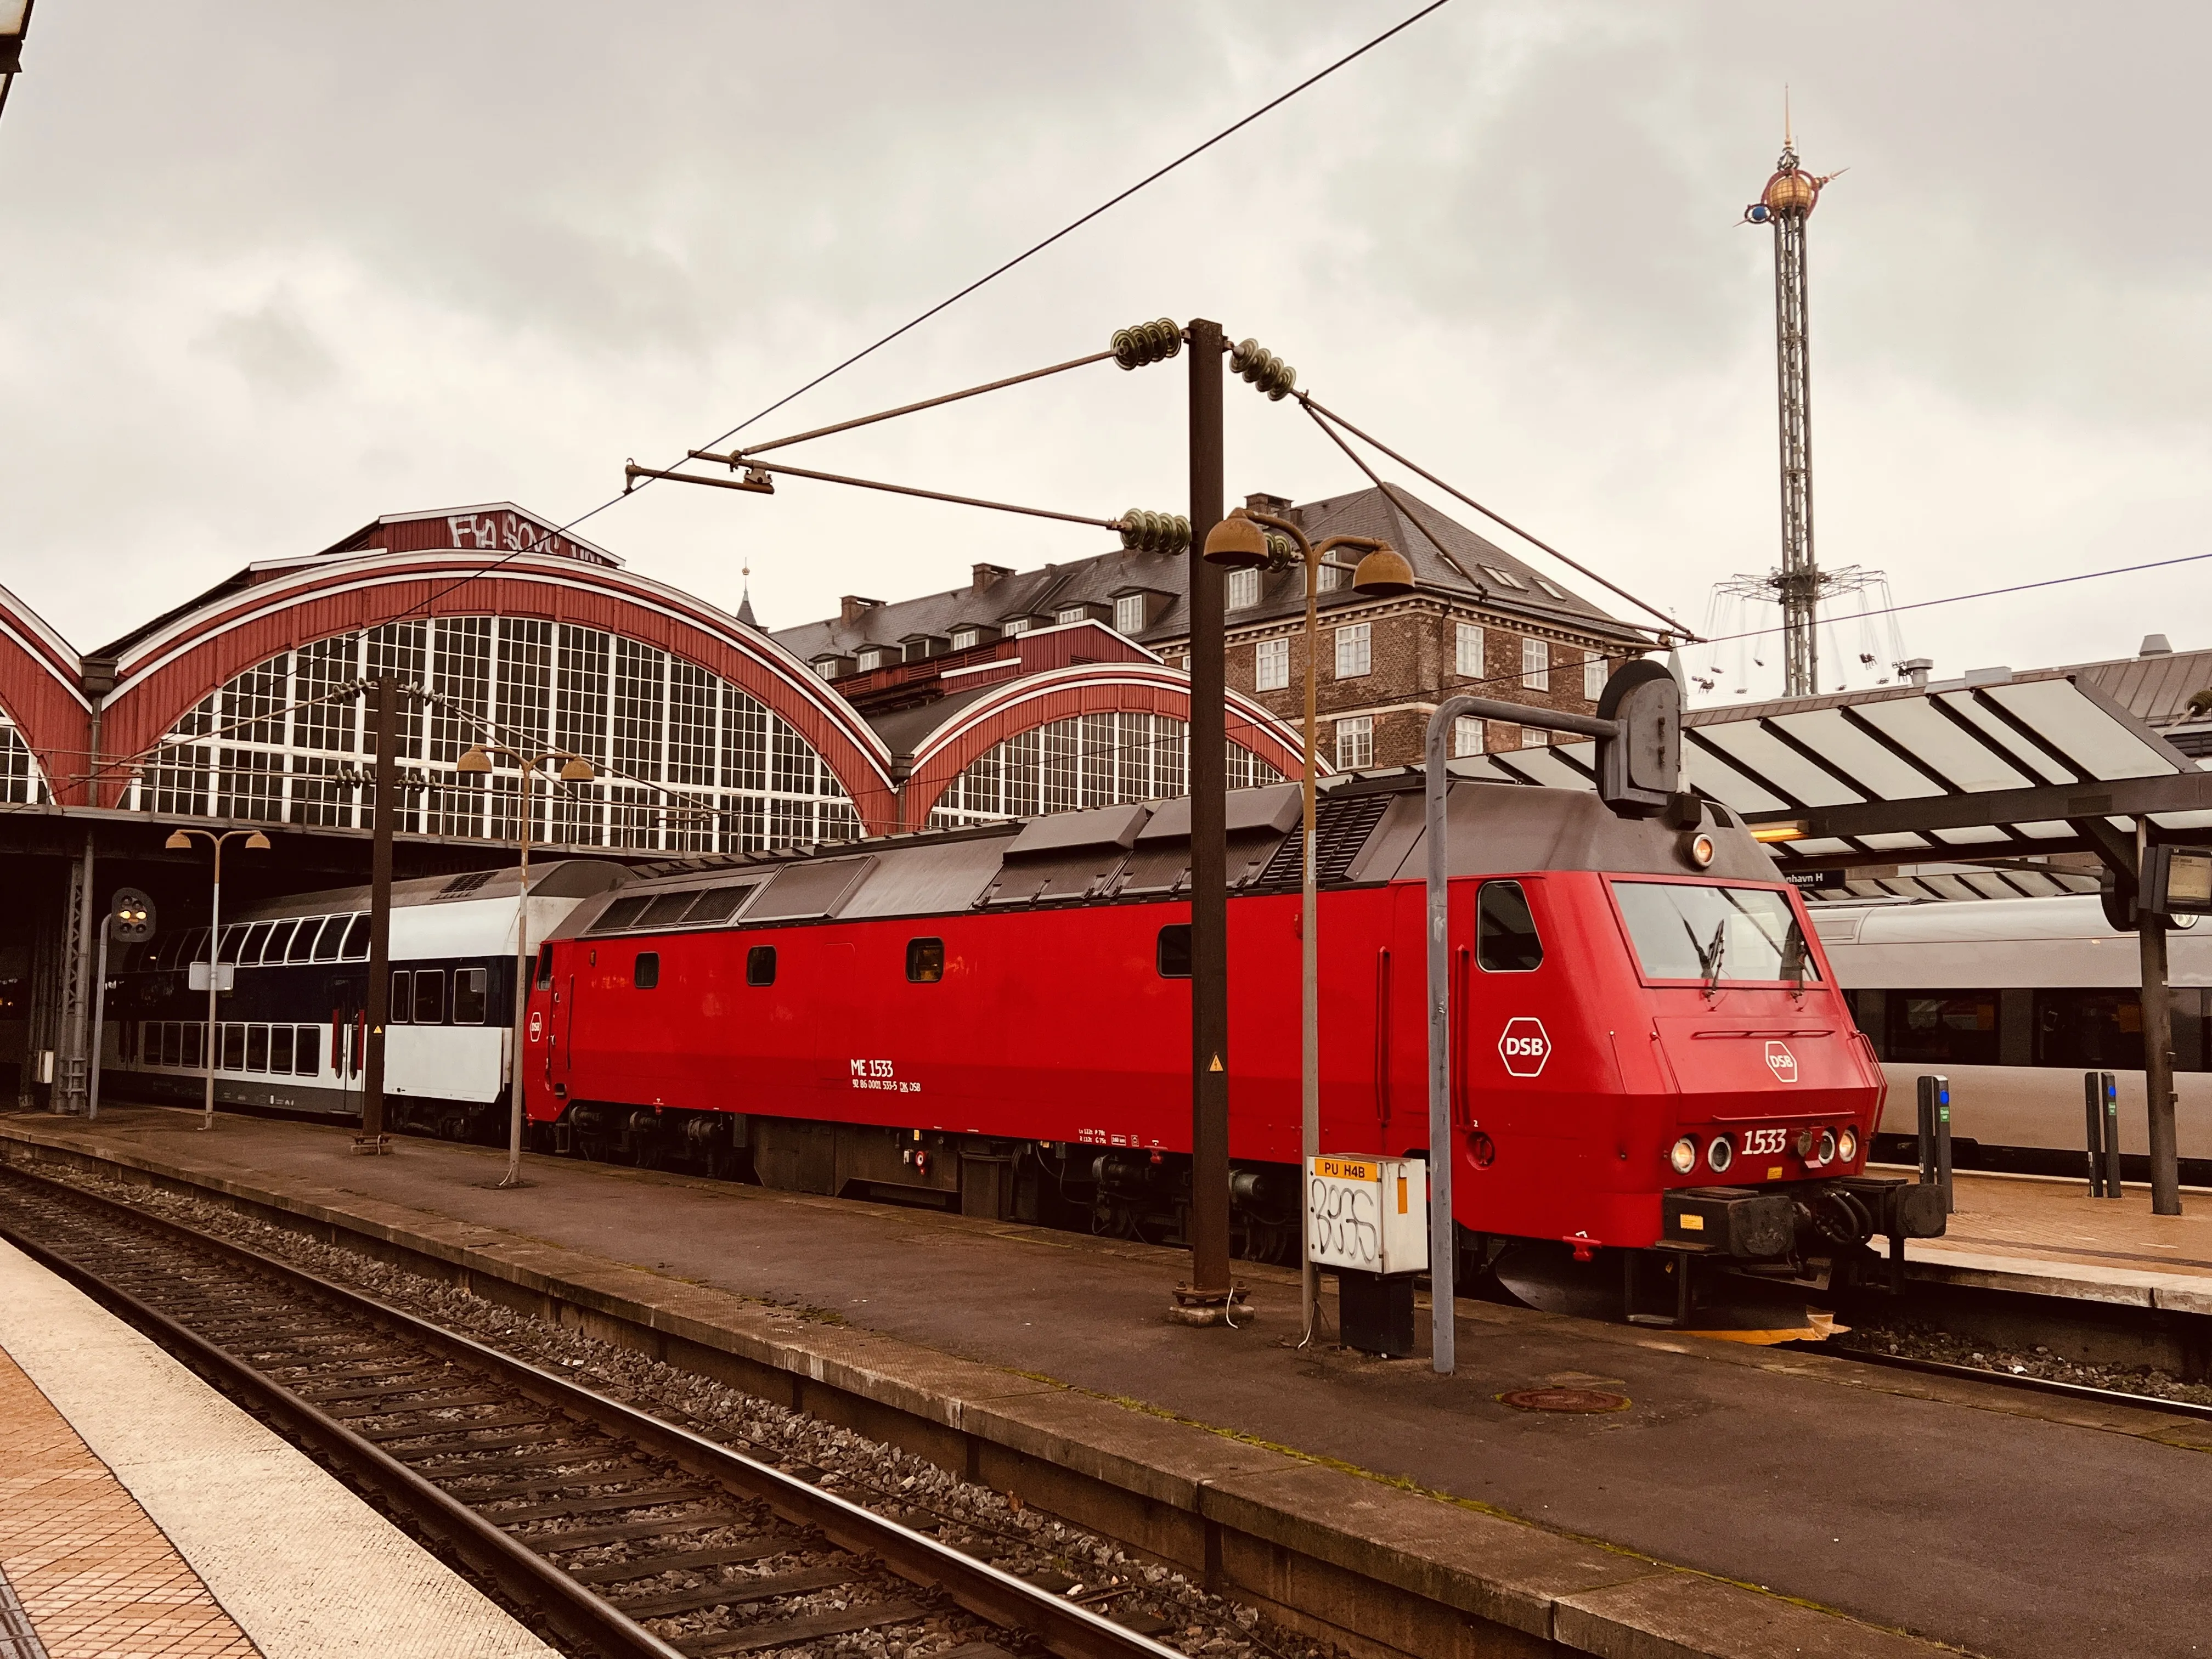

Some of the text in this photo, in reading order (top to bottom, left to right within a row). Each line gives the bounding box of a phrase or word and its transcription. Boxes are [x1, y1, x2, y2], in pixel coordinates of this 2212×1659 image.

[1815, 873, 1823, 882] H
[1506, 1037, 1543, 1056] DSB
[851, 1059, 893, 1077] ME 1533
[1769, 1055, 1793, 1068] DSB
[853, 1079, 859, 1088] 92
[883, 1081, 898, 1090] 533-5
[910, 1082, 921, 1092] DSB
[1742, 1128, 1786, 1155] 1533
[1324, 1162, 1365, 1178] PU H4B
